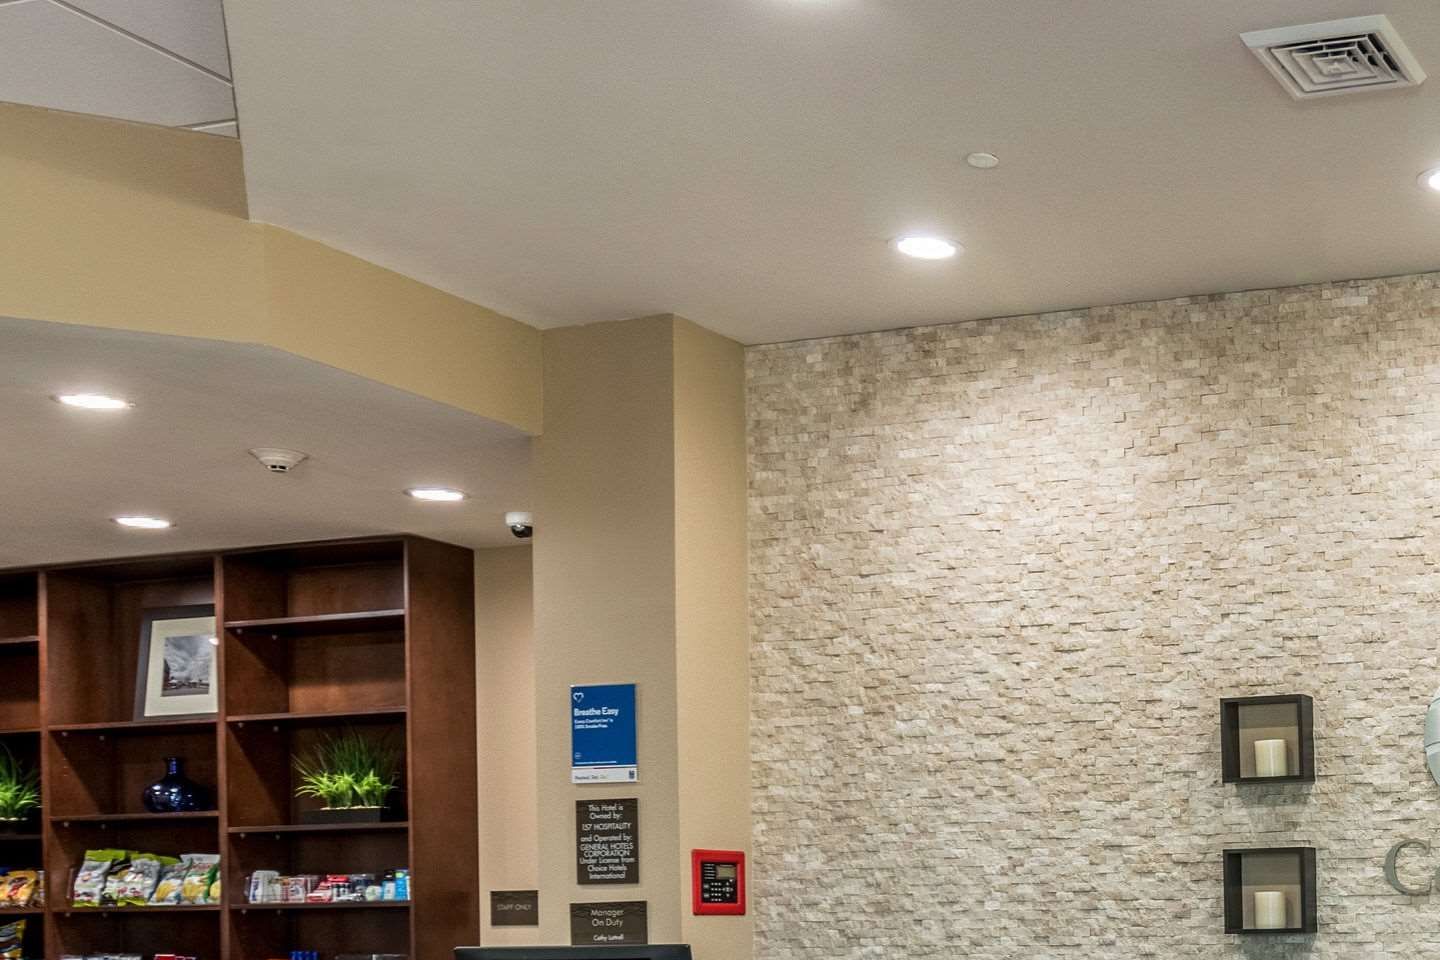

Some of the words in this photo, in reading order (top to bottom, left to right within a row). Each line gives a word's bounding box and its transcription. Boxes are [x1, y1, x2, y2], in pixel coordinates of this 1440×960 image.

[574, 708, 601, 716] Breathe
[602, 707, 619, 716] Easy
[593, 822, 632, 830] HOSPITALITY
[580, 843, 608, 851] GENERAL
[606, 918, 624, 927] Duty
